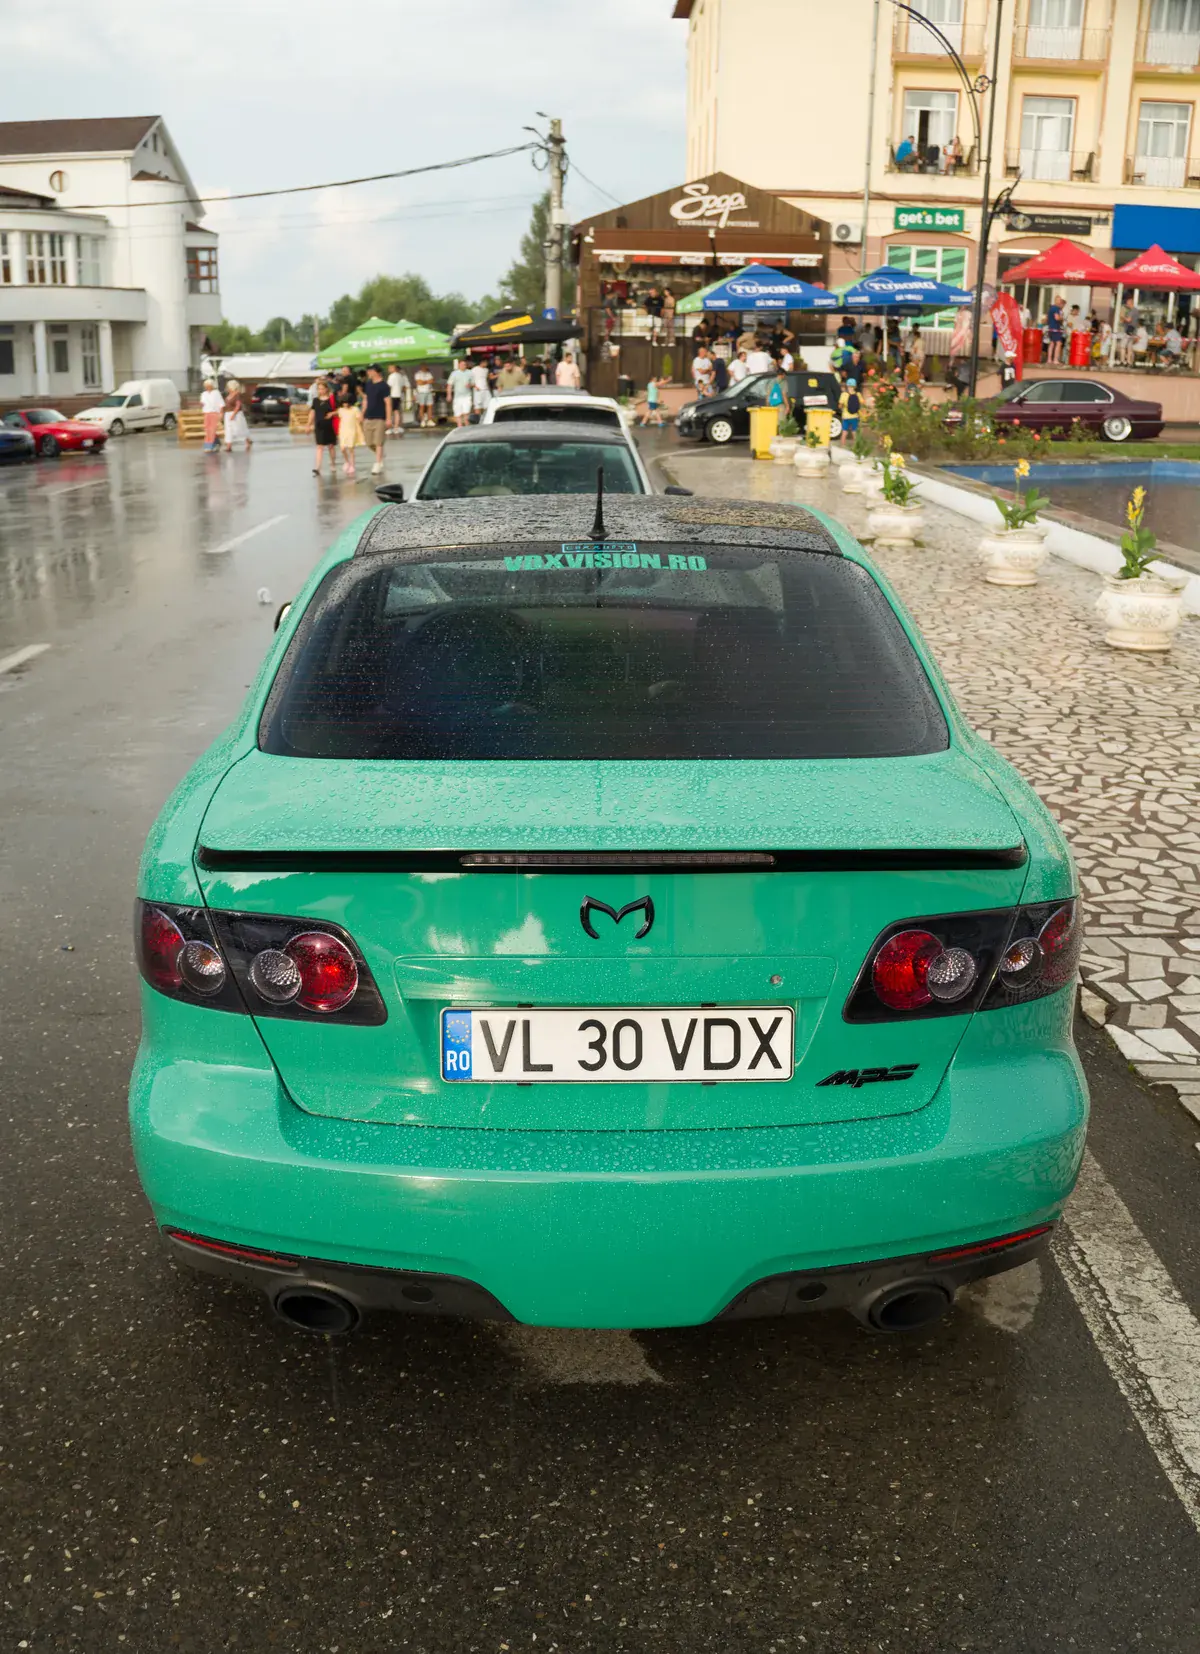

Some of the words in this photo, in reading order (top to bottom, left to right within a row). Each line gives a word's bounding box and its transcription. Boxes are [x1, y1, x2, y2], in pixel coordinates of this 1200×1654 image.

[898, 210, 933, 227] get's
[935, 211, 960, 226] bet
[731, 283, 803, 294] TUBORG
[869, 281, 937, 291] TUBORG
[479, 1019, 554, 1072] VL
[577, 1018, 643, 1072] 30
[661, 1016, 784, 1071] VDX
[446, 1050, 471, 1071] RO
[814, 1062, 921, 1089] MPS
